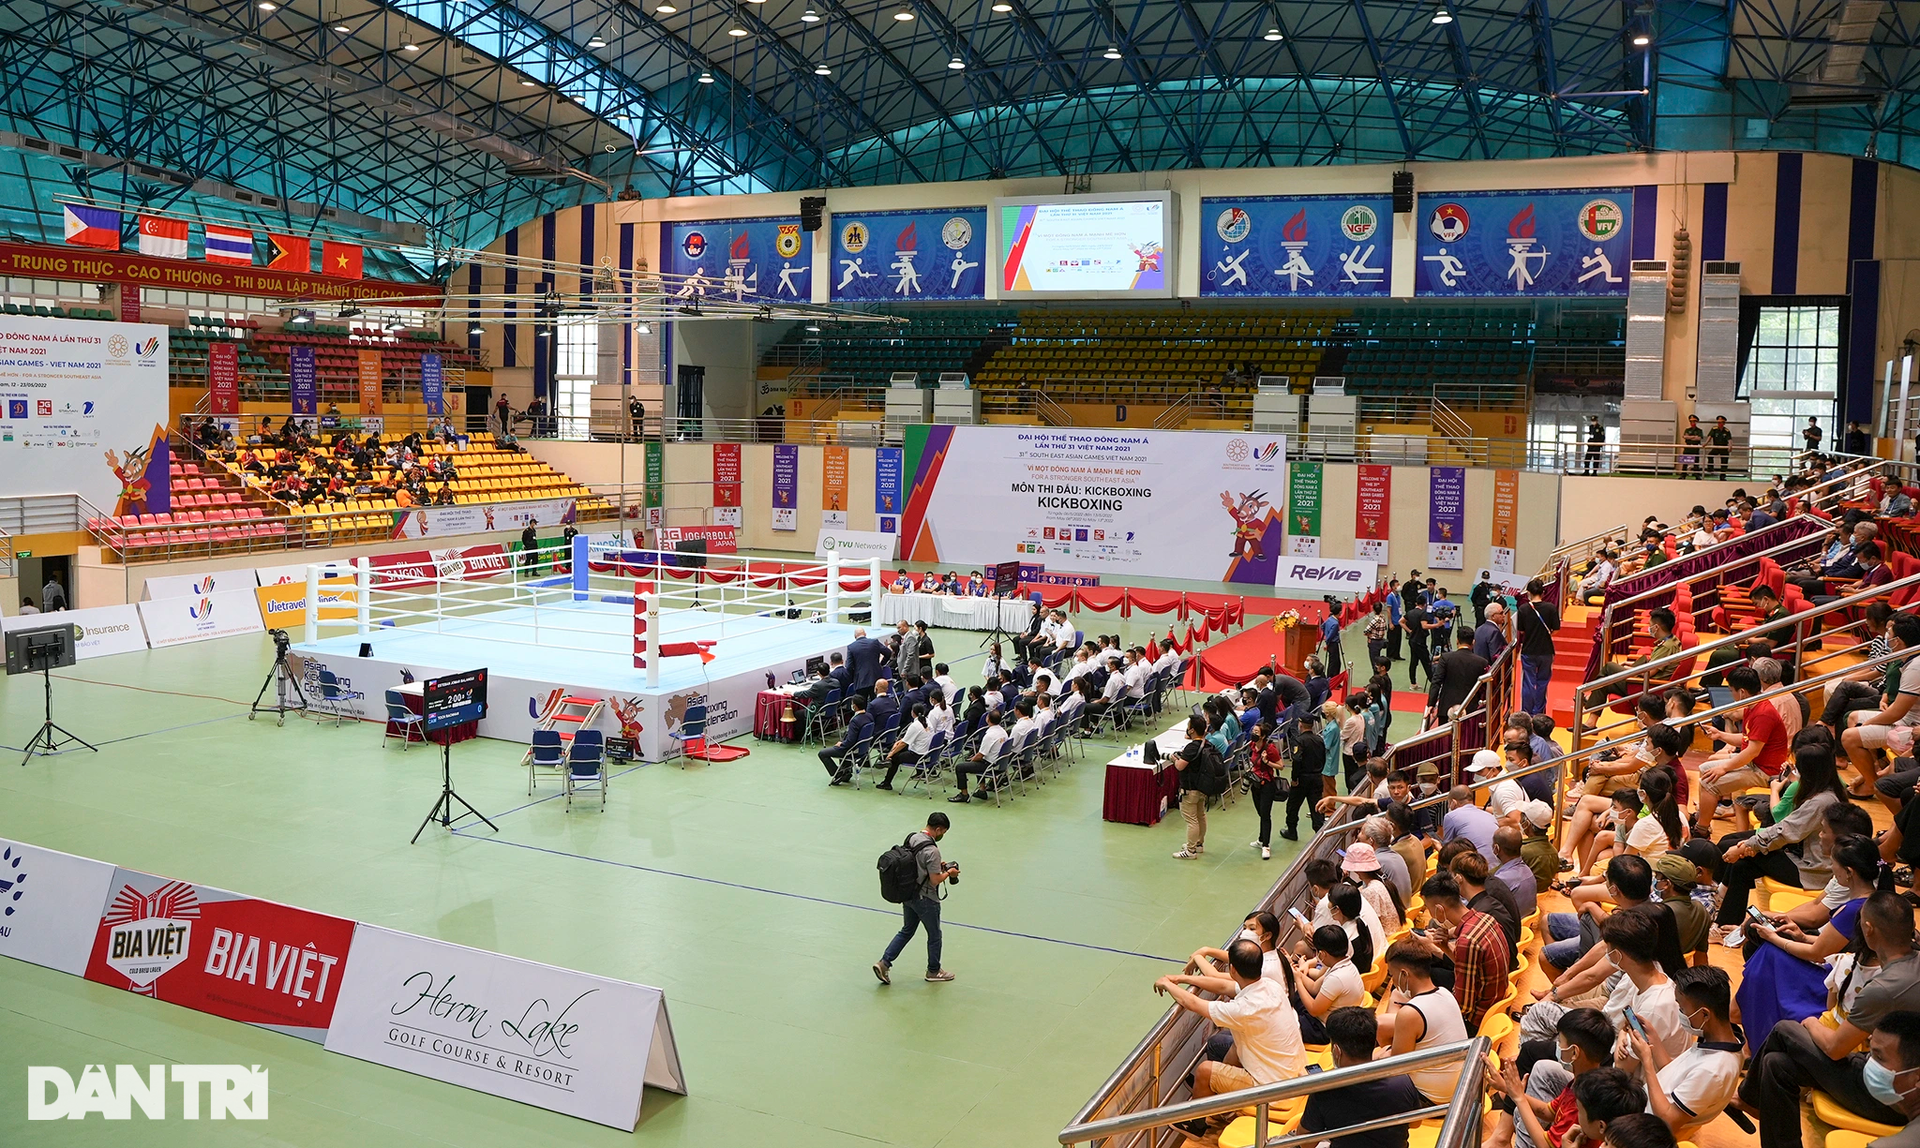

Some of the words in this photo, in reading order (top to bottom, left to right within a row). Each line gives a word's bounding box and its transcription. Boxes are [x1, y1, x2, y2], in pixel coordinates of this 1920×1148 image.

[1347, 224, 1371, 232] VGF
[1596, 222, 1613, 231] VFV
[12, 254, 68, 272] TRUNG
[72, 260, 114, 278] THỰC
[126, 264, 161, 279] CAO
[165, 268, 223, 287] THƯỢNG
[234, 275, 253, 289] THI
[257, 277, 283, 291] ĐUA
[287, 278, 309, 296] LẬP
[311, 282, 350, 297] THÀNH
[353, 286, 378, 299] TÍCH
[5, 333, 30, 341] ĐÔNG
[52, 334, 58, 343] Á
[60, 335, 75, 344] LẦN
[77, 335, 93, 344] THỨ
[1116, 404, 1127, 422] D
[1142, 436, 1149, 444] Á
[1035, 465, 1049, 473] MỘT
[1050, 465, 1070, 473] ĐÔNG
[1093, 468, 1113, 476] MẠNH
[1011, 481, 1035, 493] MÔN
[1038, 484, 1054, 494] THI
[1056, 482, 1082, 495] ĐẤU:
[1085, 486, 1152, 498] KICKBOXING
[1038, 496, 1123, 512] KICKBOXING
[683, 530, 735, 541] JOGARBOLA
[854, 540, 887, 550] Networks
[469, 556, 486, 570] BIA
[268, 598, 306, 612] Vietravel
[85, 623, 130, 636] Insurance
[304, 660, 327, 671] Asian
[686, 694, 707, 707] Asian
[112, 929, 143, 959] BIA
[147, 922, 187, 960] VIỆT
[129, 966, 138, 975] COLD
[139, 966, 149, 974] BREW
[149, 966, 162, 974] LAGER
[204, 927, 261, 986] BIA
[265, 941, 339, 1008] VIỆT
[390, 971, 492, 1039] Heron
[501, 988, 600, 1059] Lake
[496, 1055, 507, 1069] &
